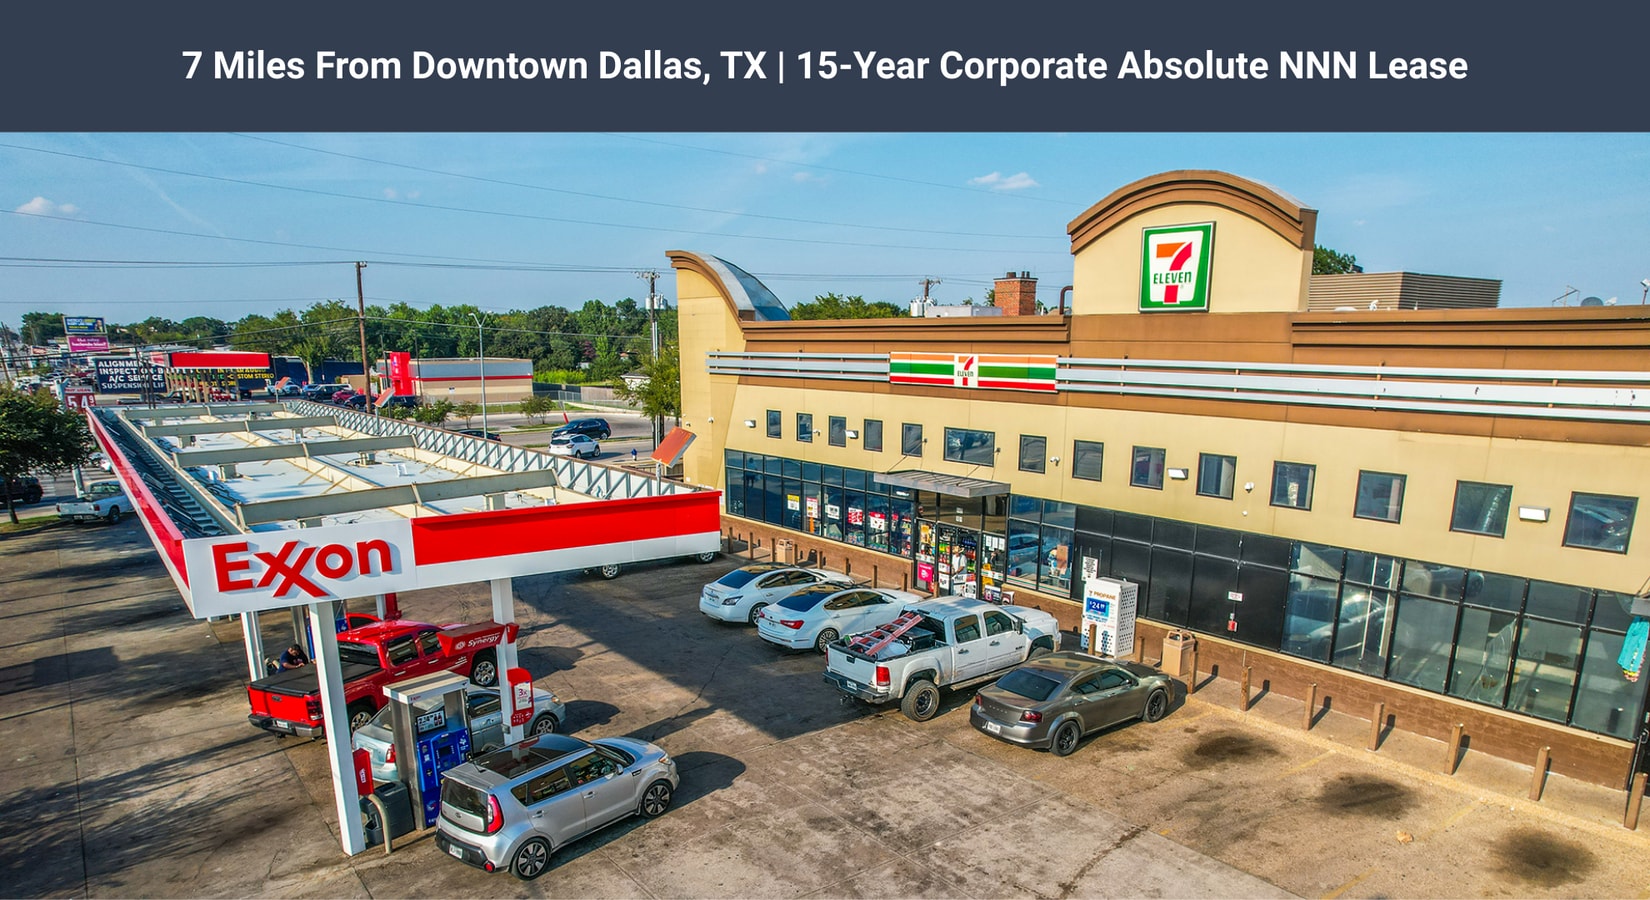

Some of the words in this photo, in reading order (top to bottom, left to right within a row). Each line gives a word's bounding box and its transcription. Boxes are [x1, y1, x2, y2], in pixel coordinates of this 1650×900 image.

[1156, 241, 1193, 303] 7
[958, 356, 974, 386] 7
[212, 539, 392, 598] Exxon
[1094, 591, 1116, 600] PROPANE
[467, 635, 500, 647] Synergy
